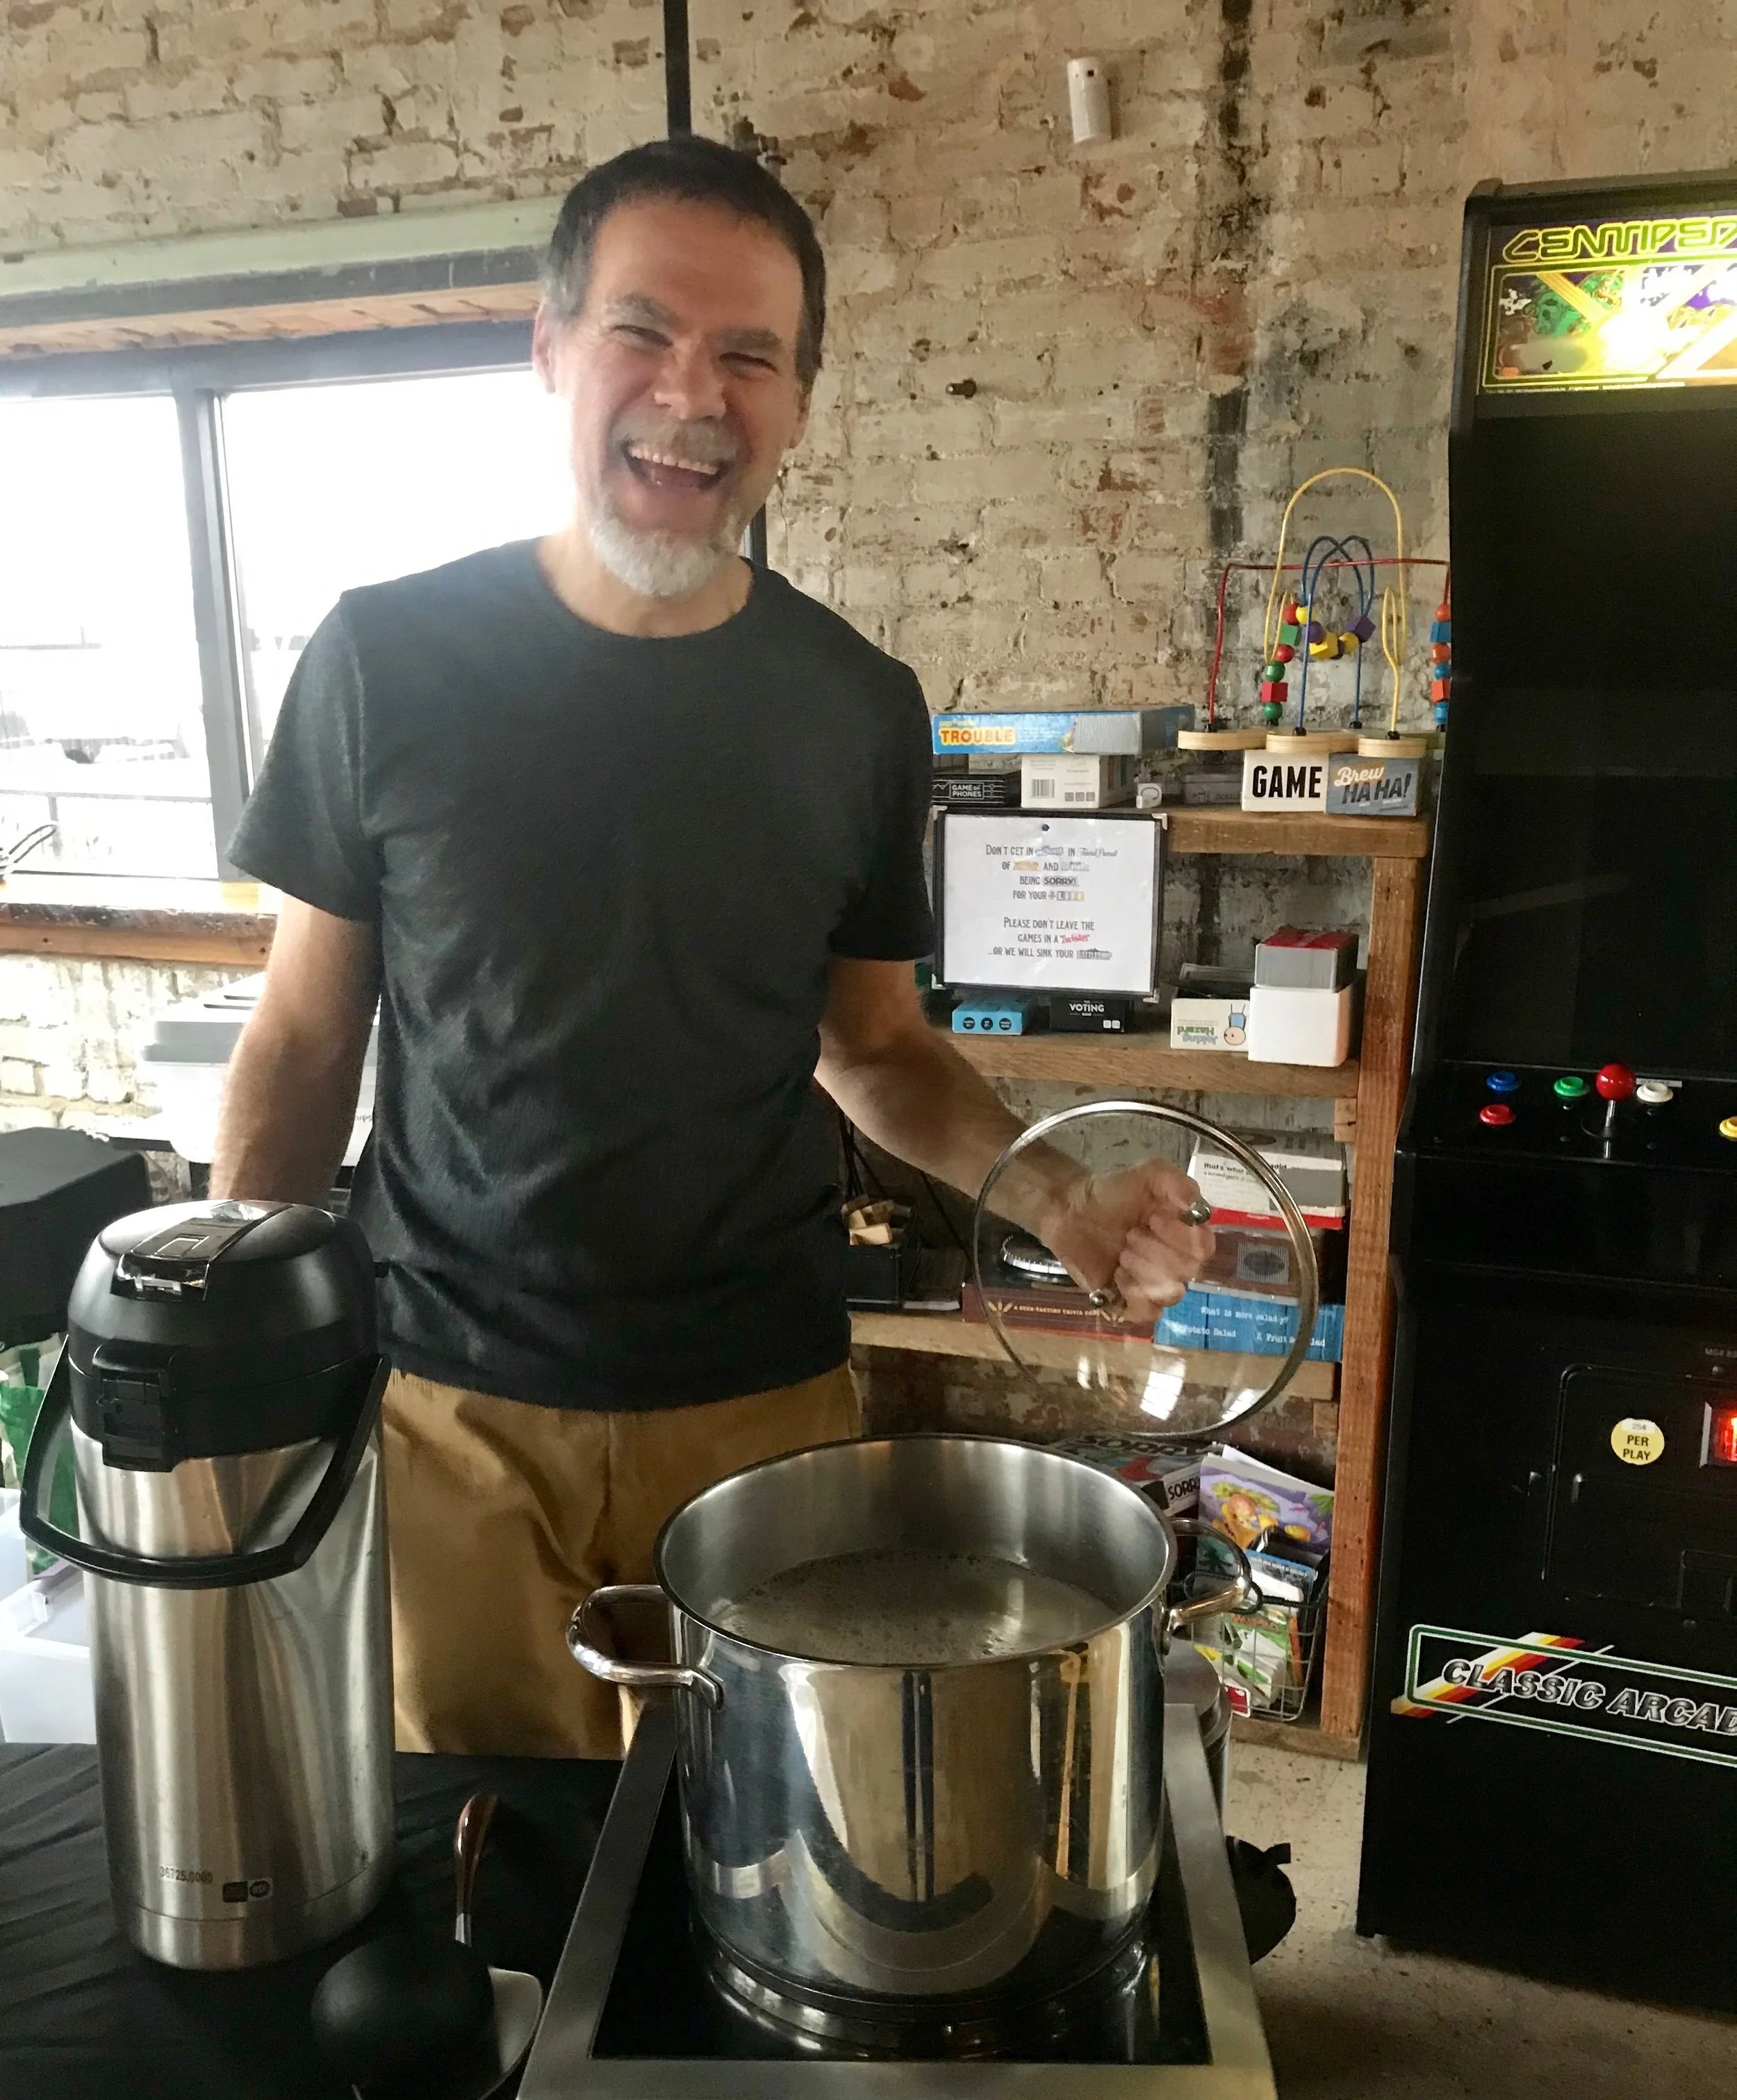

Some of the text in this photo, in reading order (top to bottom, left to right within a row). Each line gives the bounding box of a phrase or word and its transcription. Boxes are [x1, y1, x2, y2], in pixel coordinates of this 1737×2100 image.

[941, 730, 1015, 743] TROUBLE
[1252, 765, 1322, 798] GAME
[1334, 766, 1385, 787] Brew
[1342, 773, 1413, 805] HA HA!
[1026, 847, 1033, 856] IN
[1068, 847, 1076, 856] IN
[1002, 862, 1011, 870] OF
[1044, 862, 1059, 871] AND
[1019, 876, 1040, 885] BEING
[1013, 890, 1026, 900] FOR
[1029, 891, 1047, 901] YOUR
[1032, 918, 1054, 929] DON'T
[1056, 921, 1078, 930] LEAVE
[1080, 921, 1094, 931] THE
[1018, 933, 1042, 943] GAMES
[1044, 935, 1051, 943] IN
[1005, 946, 1016, 956] WE
[1018, 947, 1035, 957] WILL
[1037, 948, 1053, 958] SINK
[1055, 949, 1073, 958] YOUR
[1069, 1003, 1105, 1012] VOTING
[1201, 1306, 1221, 1315] What
[1627, 1434, 1649, 1447] PER
[1622, 1447, 1651, 1461] PLAY
[1167, 1475, 1200, 1501] SORR
[1442, 1659, 1737, 1737] CLASSIC ARCAD
